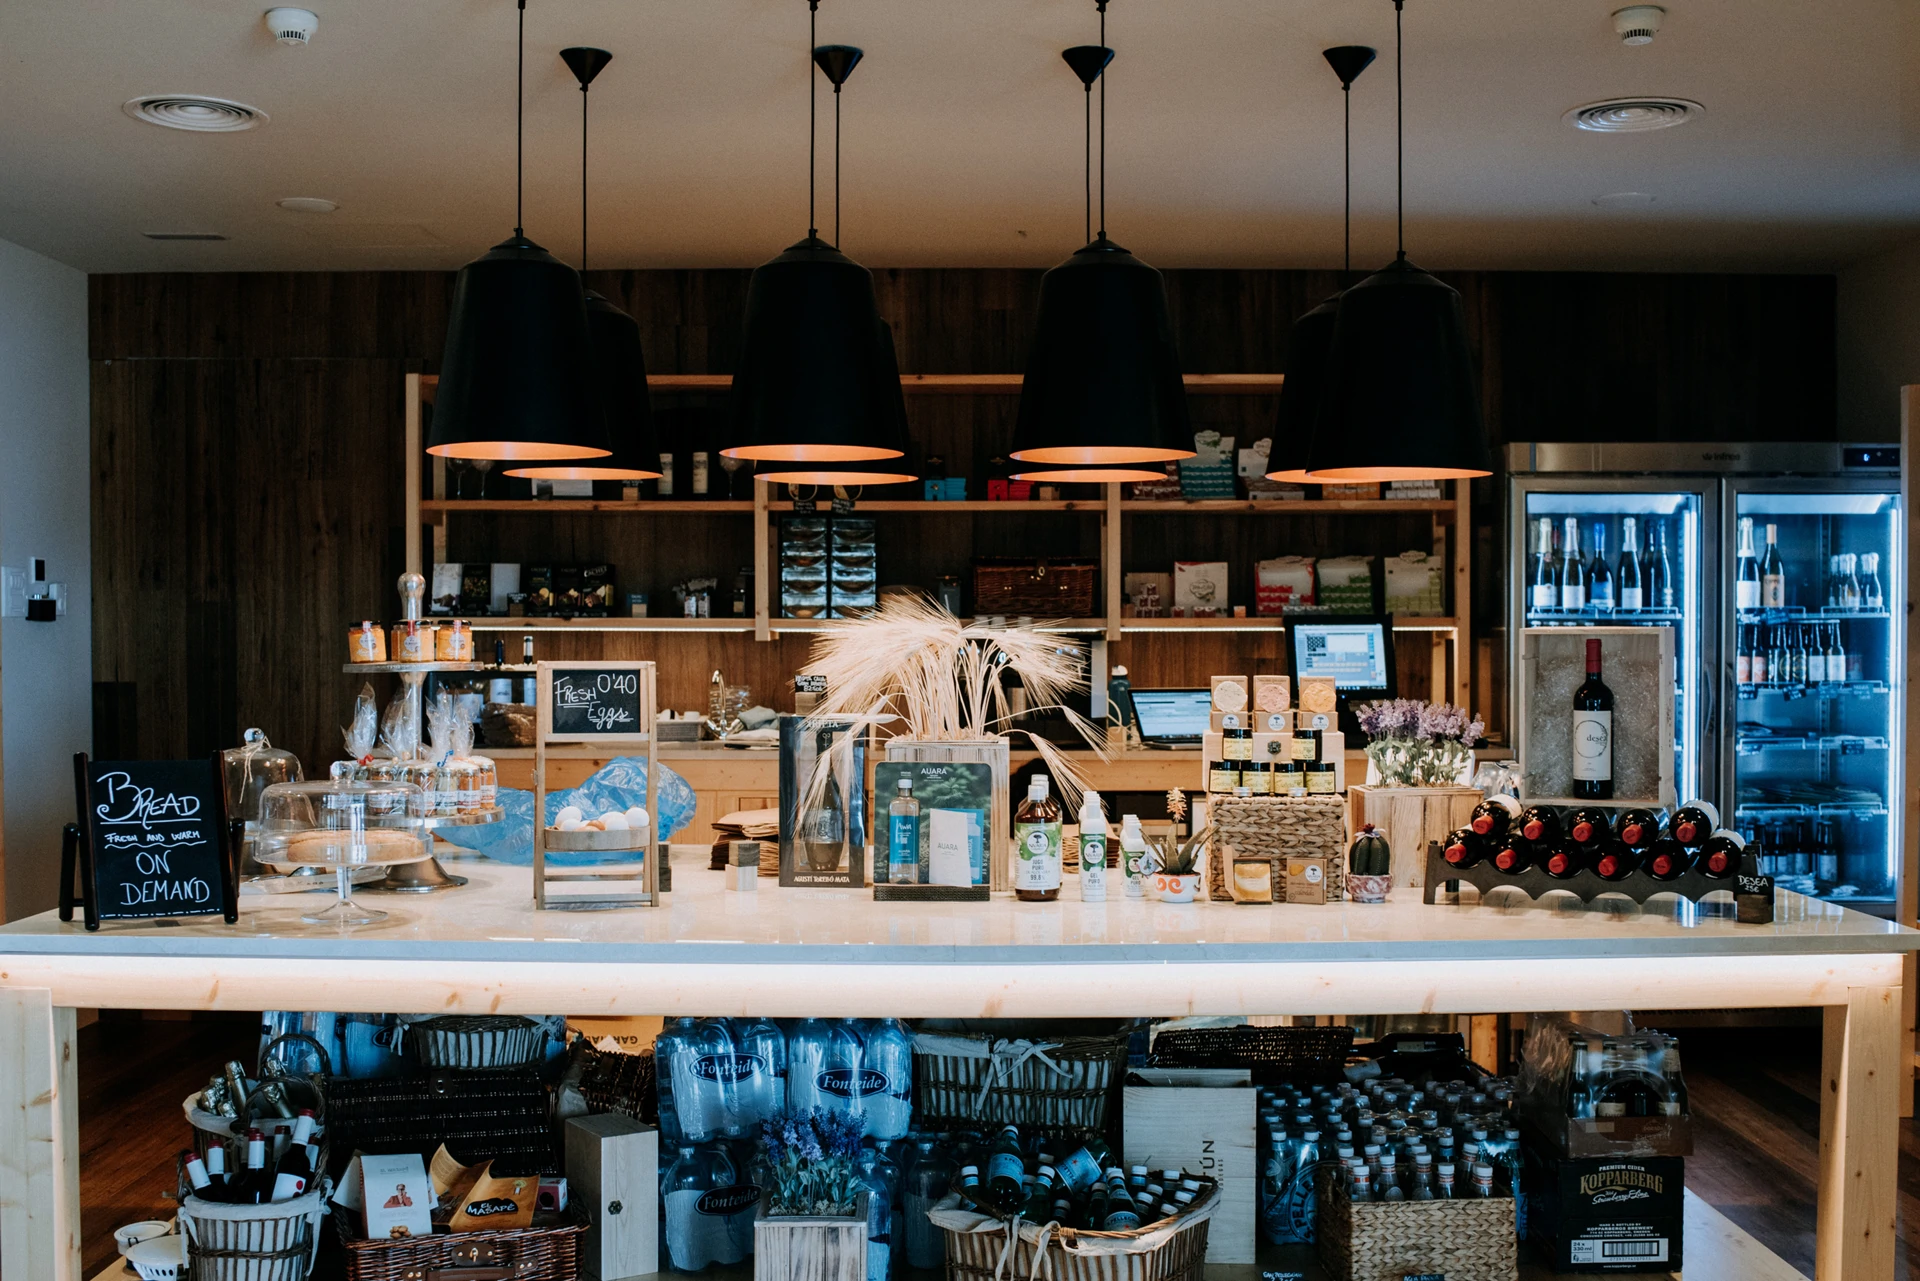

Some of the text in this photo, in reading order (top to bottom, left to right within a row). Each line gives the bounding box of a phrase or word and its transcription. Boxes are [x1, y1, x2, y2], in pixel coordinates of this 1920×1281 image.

[587, 700, 629, 730] Eggs
[920, 767, 948, 775] AUARA
[146, 833, 165, 842] AND
[171, 830, 201, 840] WARM
[937, 842, 959, 851] AUARA
[135, 850, 172, 875] ON
[1738, 875, 1769, 887] DESEA
[119, 877, 210, 905] DEMAND
[822, 1074, 883, 1091] Fonteide
[1199, 1141, 1214, 1176] ÚN
[1598, 1164, 1646, 1172] PREMIUM CIDER
[1580, 1170, 1663, 1195] KOPPARBERG
[703, 1188, 758, 1210] Fonteide
